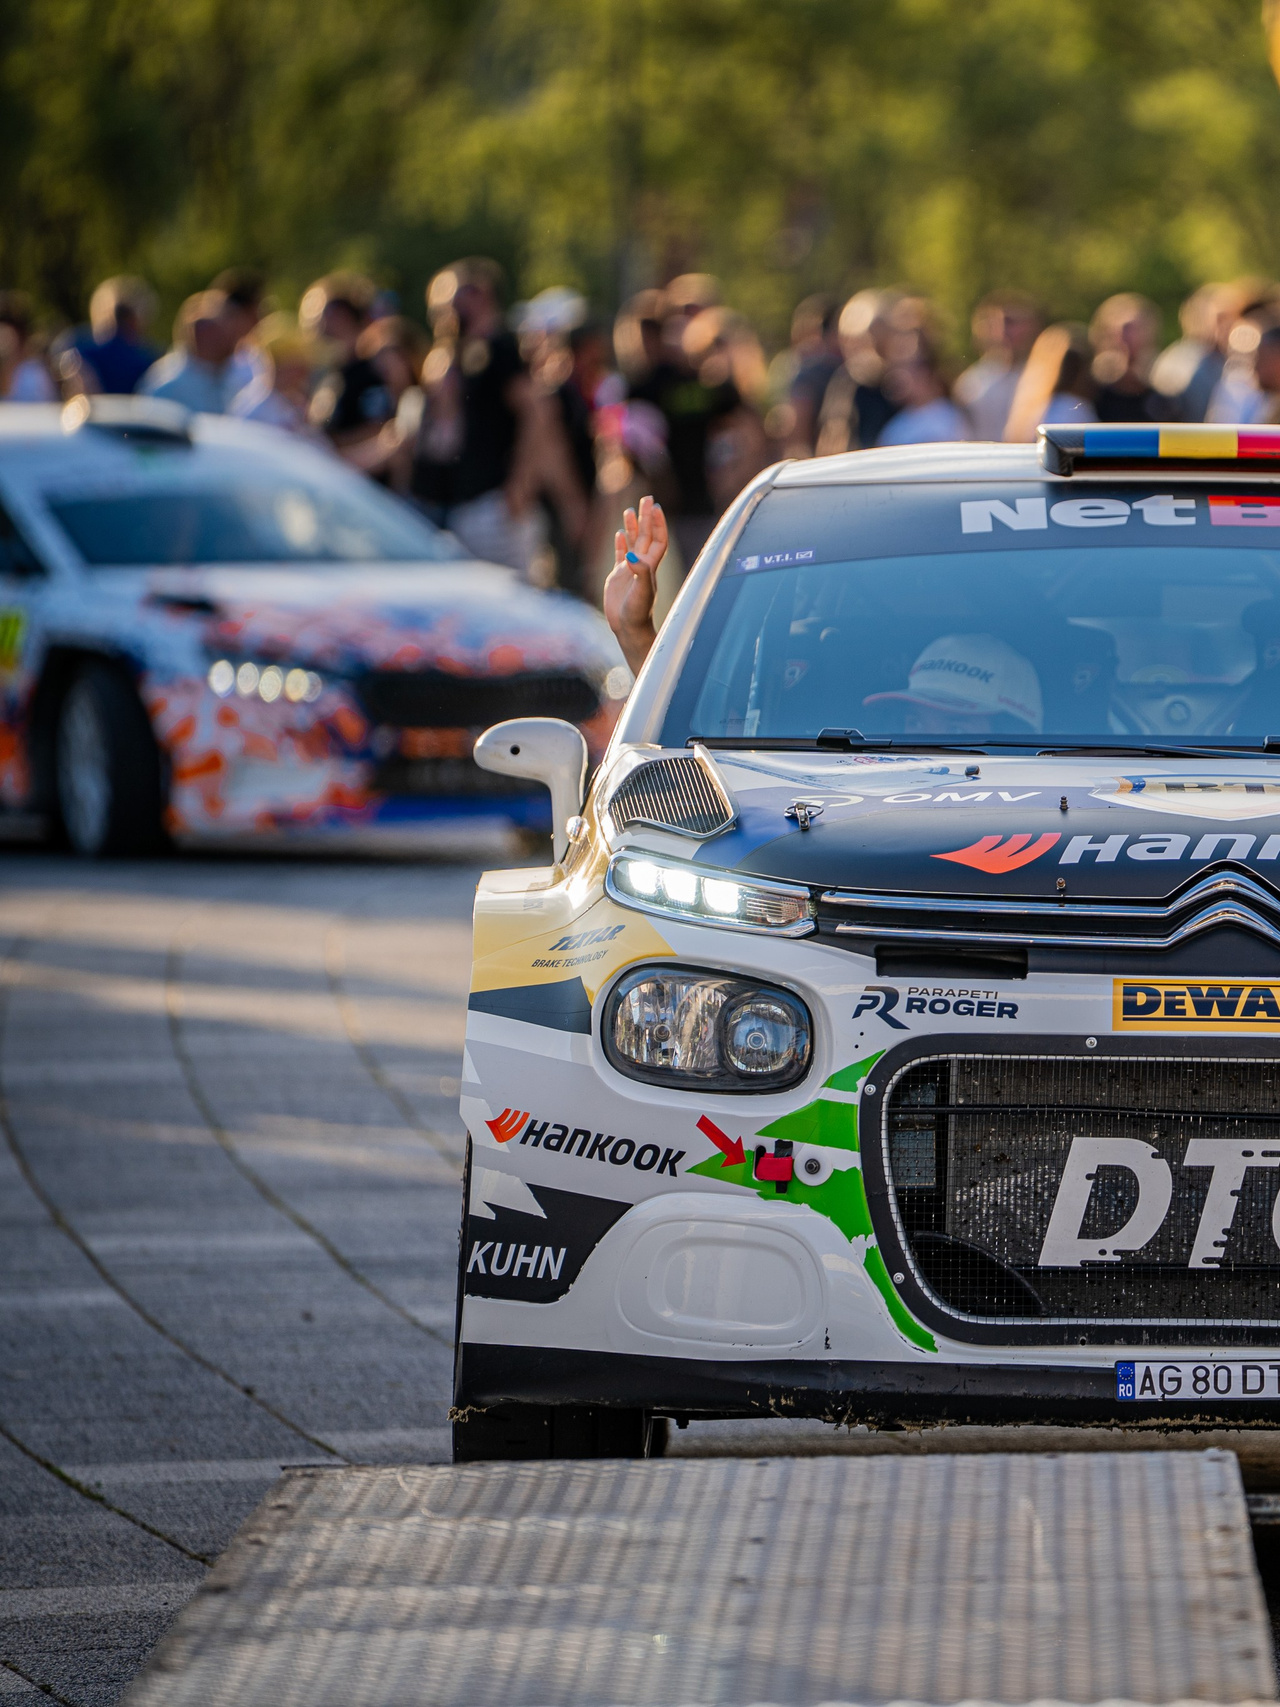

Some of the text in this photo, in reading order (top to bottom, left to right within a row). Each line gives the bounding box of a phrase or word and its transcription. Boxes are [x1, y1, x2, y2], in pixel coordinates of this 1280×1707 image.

[763, 553, 793, 564] V.T.I.
[882, 791, 1042, 803] OMV
[531, 949, 609, 968] BRAKE TECHNOLOGY
[908, 986, 999, 1000] PARAPETI
[905, 997, 1019, 1019] ROGER
[466, 1240, 567, 1280] KUHN
[1138, 1365, 1183, 1396] AG
[1191, 1365, 1232, 1395] 80
[1118, 1383, 1133, 1397] RO
